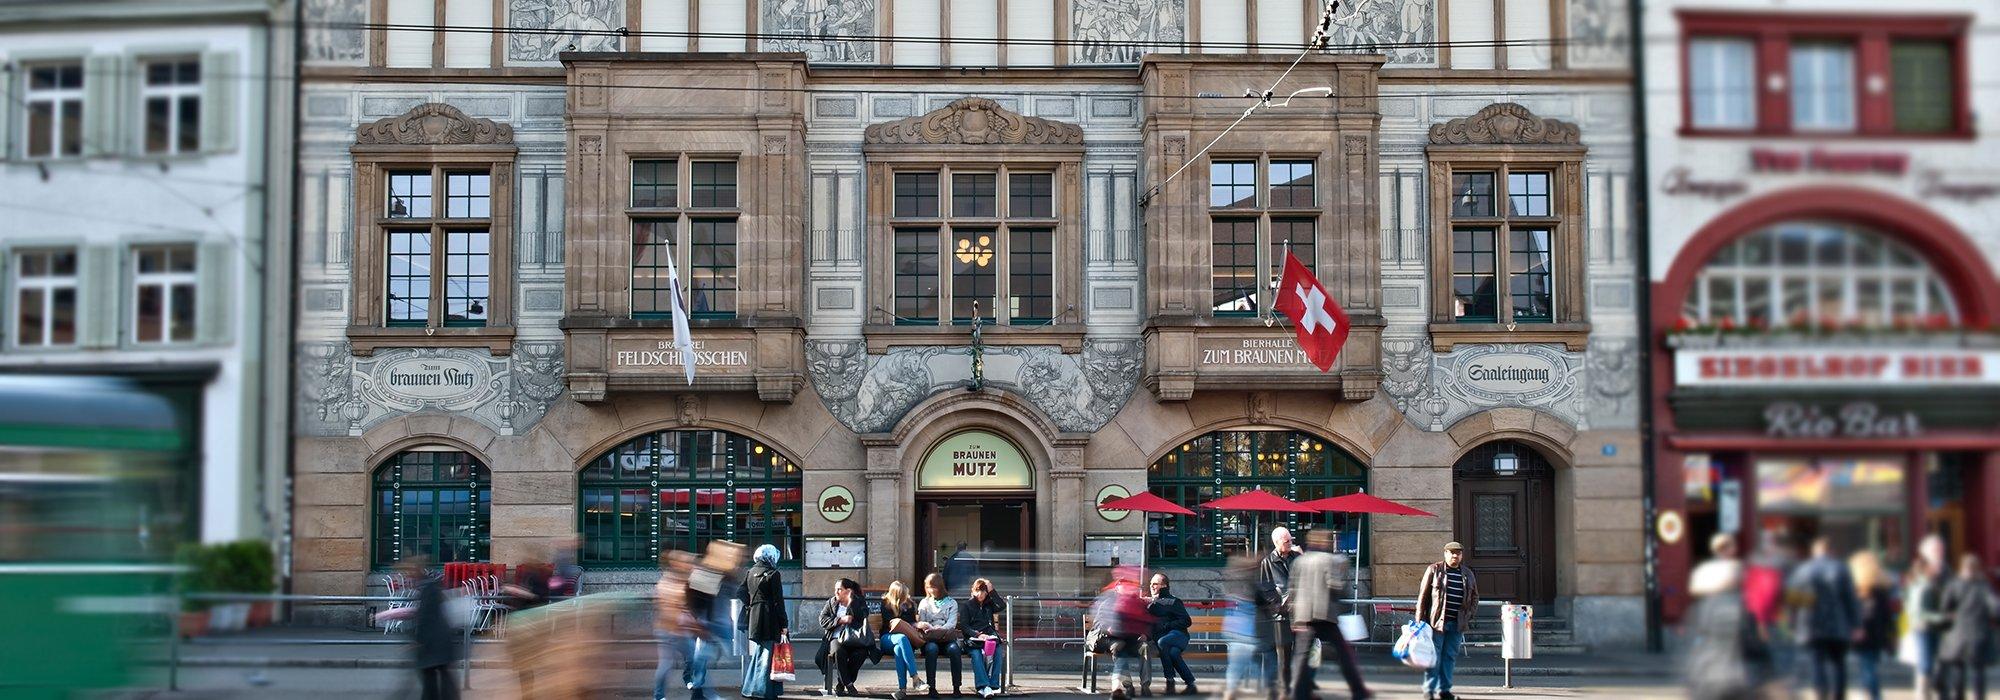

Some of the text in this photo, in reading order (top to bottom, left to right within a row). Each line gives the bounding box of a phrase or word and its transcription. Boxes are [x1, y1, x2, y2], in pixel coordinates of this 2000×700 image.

[1243, 340, 1293, 348] BIERHALLE
[1203, 349, 1230, 364] ZUM
[1234, 349, 1294, 364] BRAUNEN
[390, 367, 441, 386] braunen
[1468, 364, 1550, 384] Saaleingang
[1763, 402, 1921, 437] Rio Bar
[953, 451, 997, 460] BRAUNEN
[953, 462, 997, 476] MUTZ
